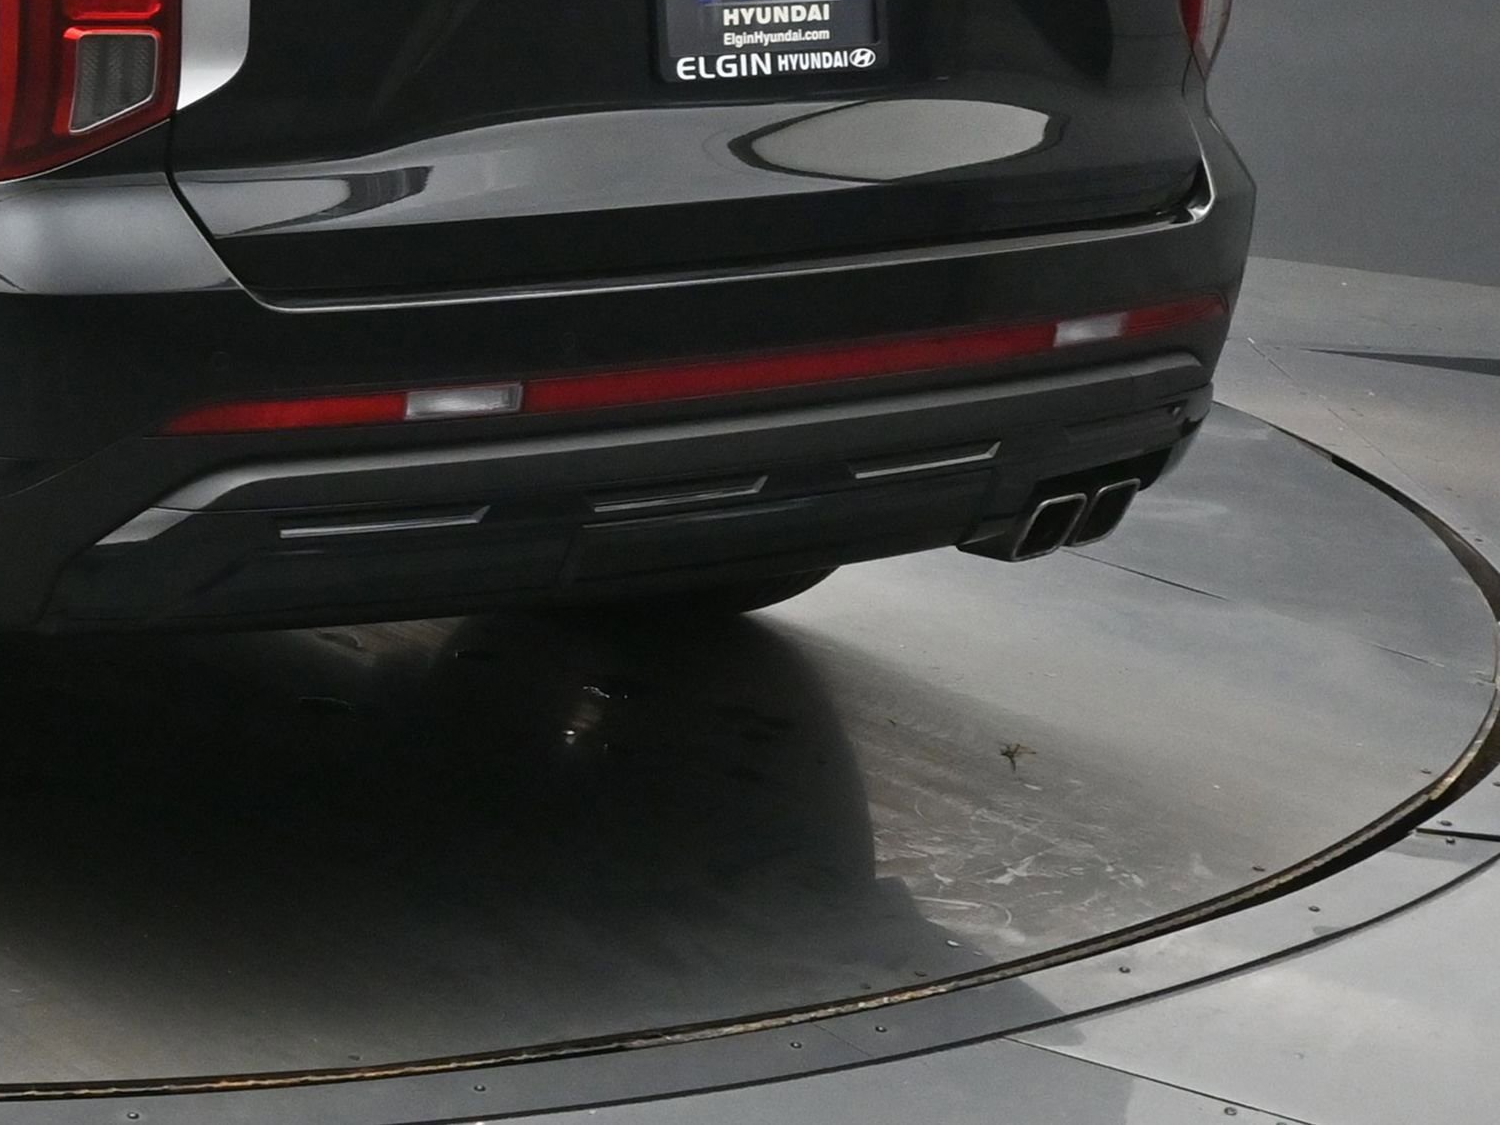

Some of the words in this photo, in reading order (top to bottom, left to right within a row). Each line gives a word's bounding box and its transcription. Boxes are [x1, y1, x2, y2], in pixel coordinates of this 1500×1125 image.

[723, 4, 830, 26] HYUNDAI
[724, 29, 830, 48] ElginHyundai.com
[676, 52, 772, 80] ELGIN
[778, 50, 848, 72] HYUNDAI
